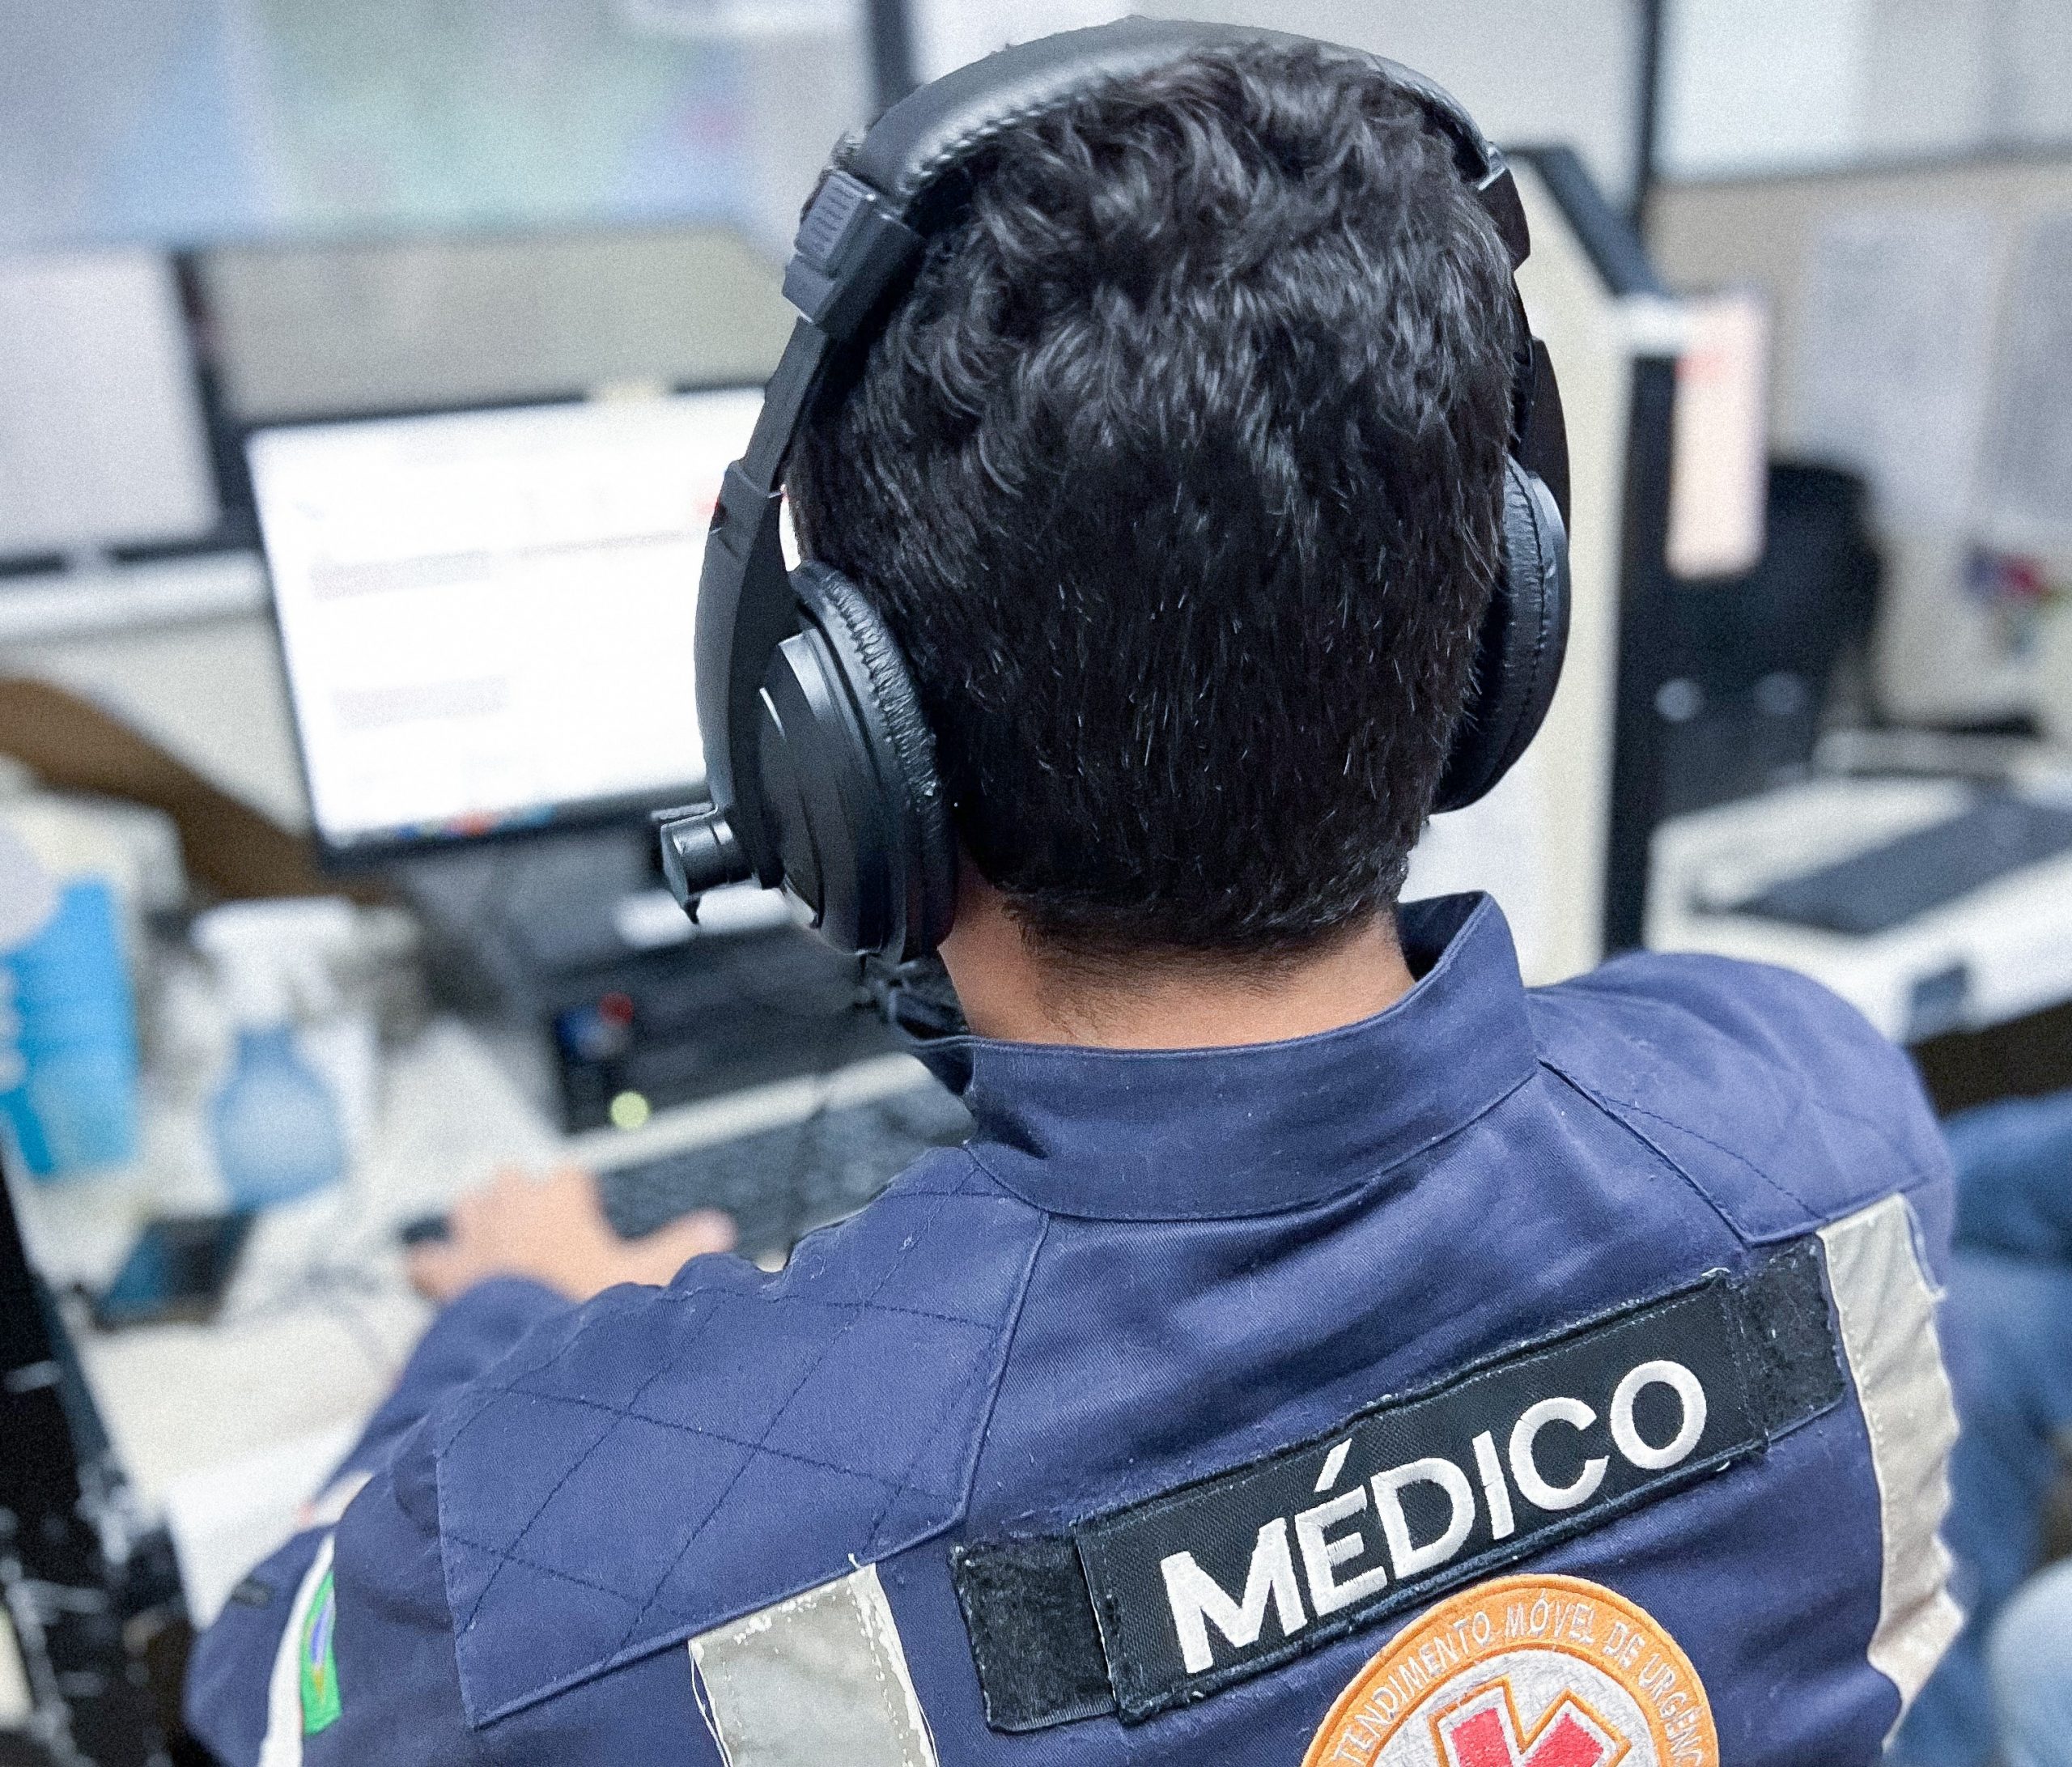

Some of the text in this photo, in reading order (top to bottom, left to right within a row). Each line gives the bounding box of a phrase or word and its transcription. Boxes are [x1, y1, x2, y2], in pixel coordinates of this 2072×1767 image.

[1160, 1360, 1707, 1674] MÉDICO
[1505, 1588, 1594, 1644] MÓVEL
[1603, 1620, 1645, 1668] DE
